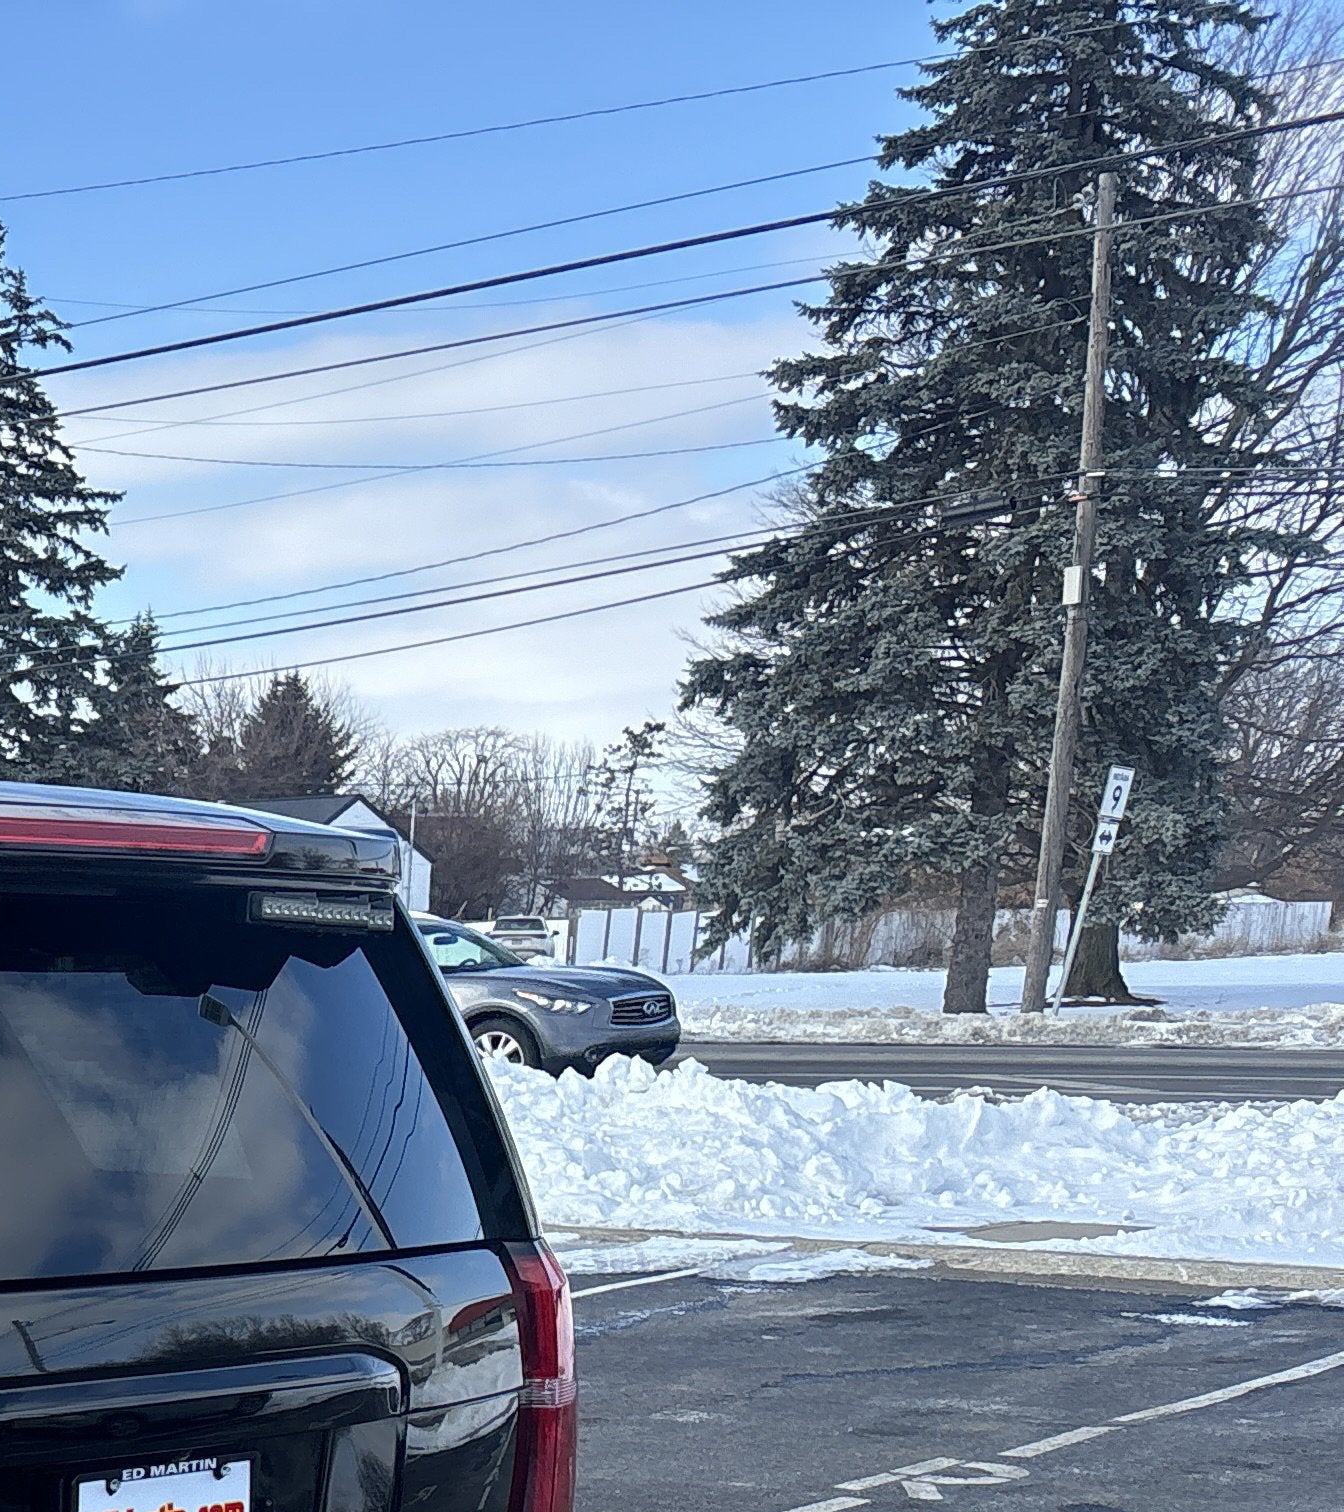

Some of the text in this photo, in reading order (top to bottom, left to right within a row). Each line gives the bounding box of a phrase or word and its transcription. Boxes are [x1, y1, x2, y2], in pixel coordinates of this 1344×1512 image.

[1110, 785, 1123, 813] 9
[122, 1457, 218, 1481] ED MARTIN
